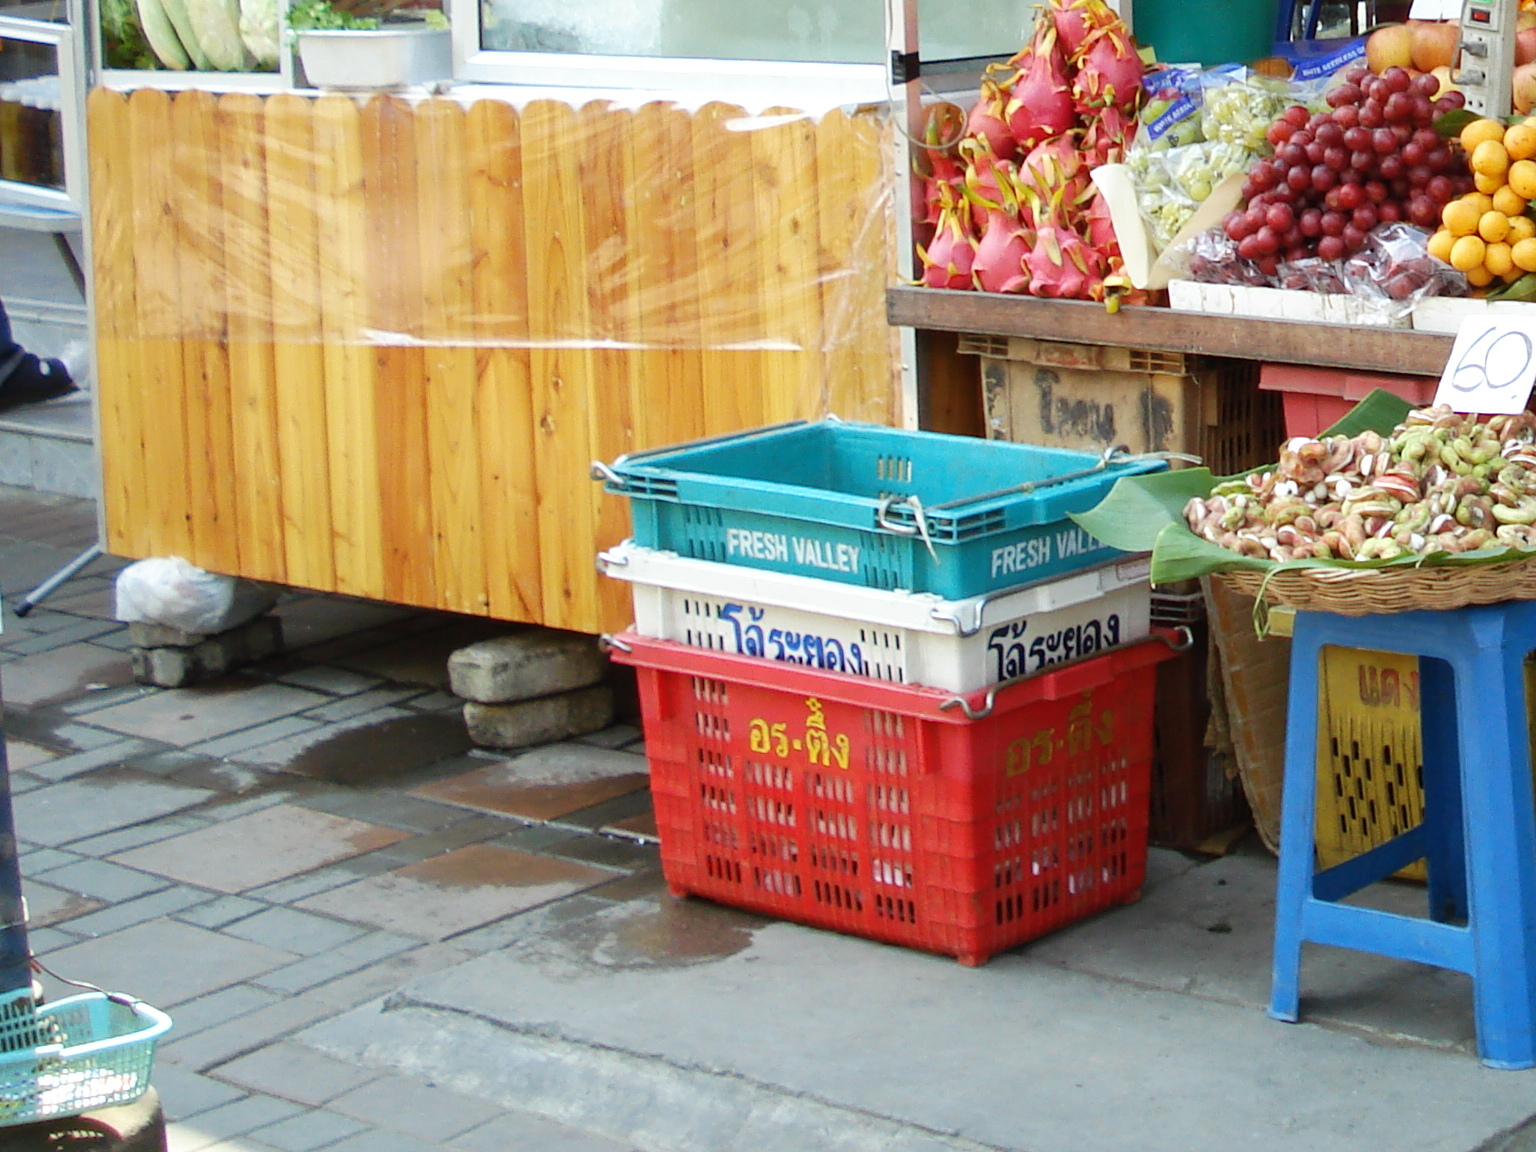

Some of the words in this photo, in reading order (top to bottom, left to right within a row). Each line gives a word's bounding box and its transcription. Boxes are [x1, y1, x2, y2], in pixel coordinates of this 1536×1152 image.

[726, 528, 788, 563] FRESH
[791, 535, 861, 573] VALLEY
[991, 535, 1051, 578] FRESH
